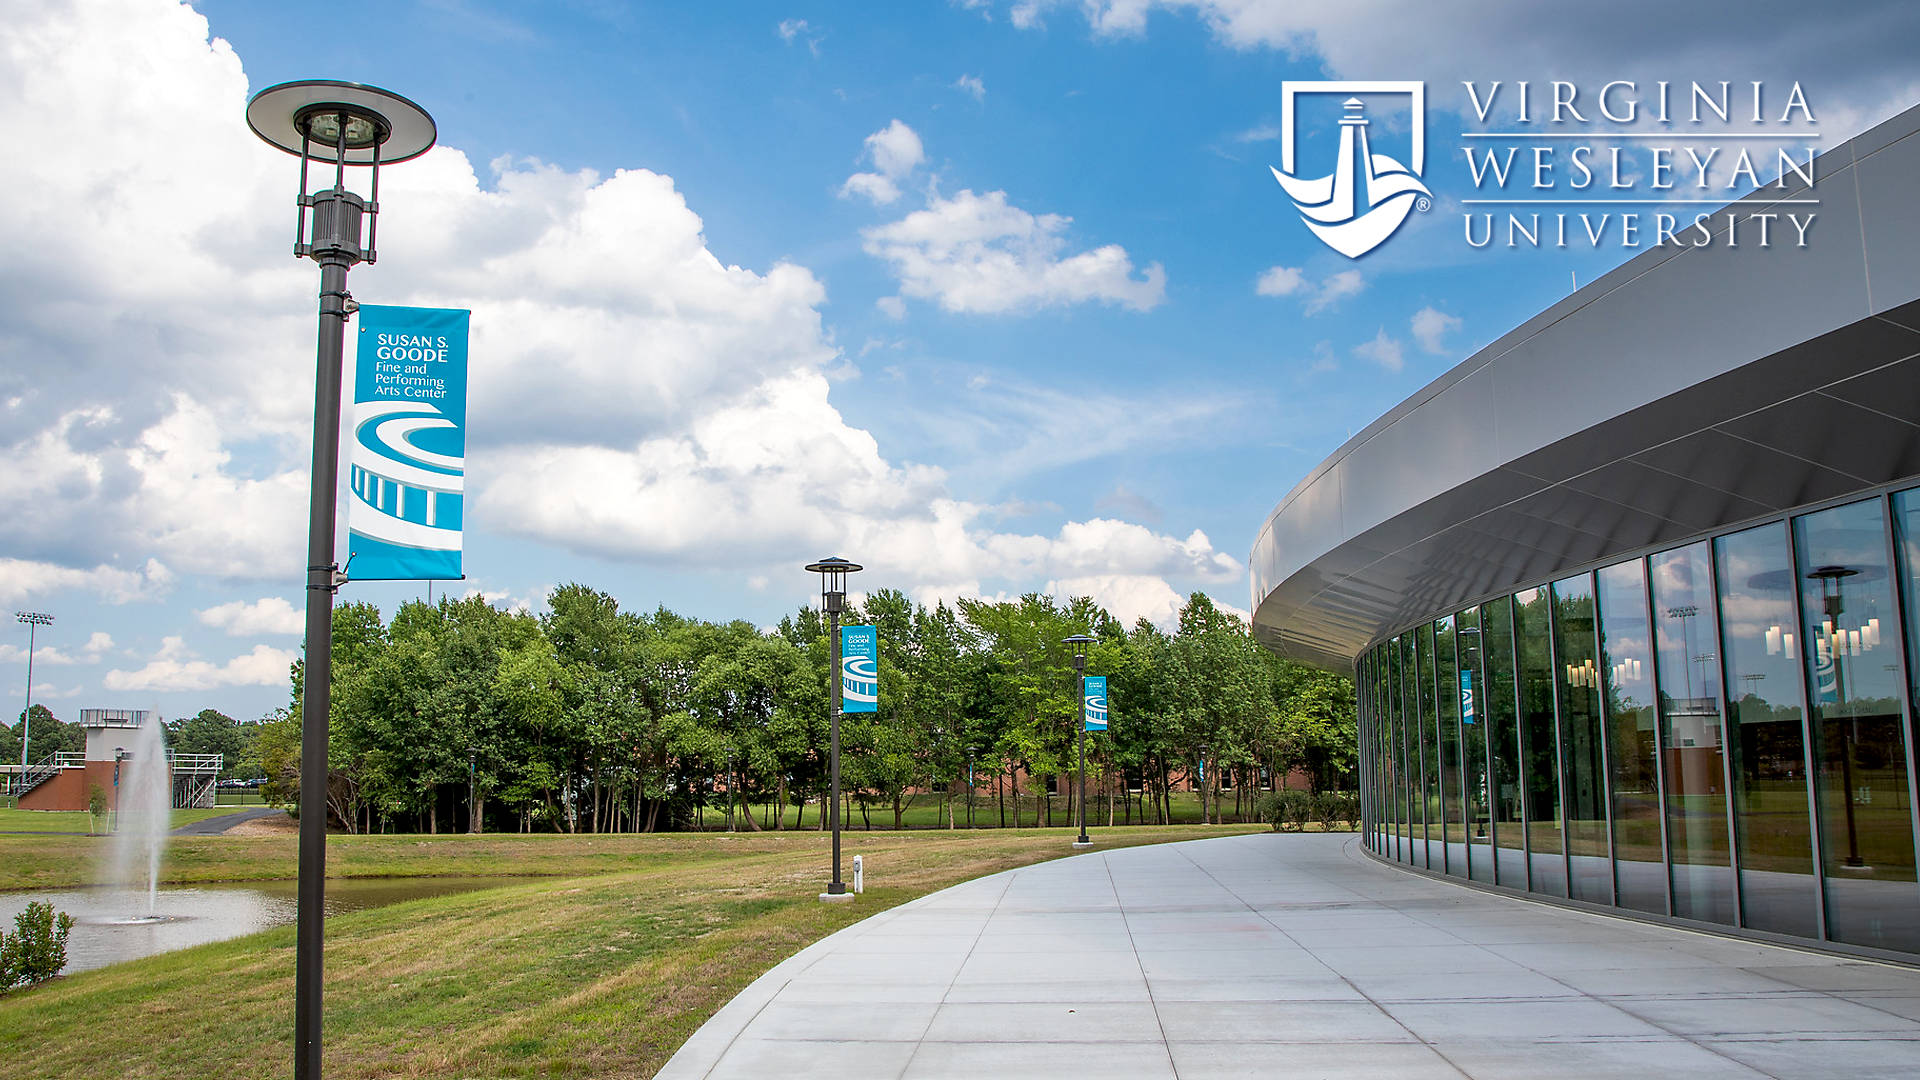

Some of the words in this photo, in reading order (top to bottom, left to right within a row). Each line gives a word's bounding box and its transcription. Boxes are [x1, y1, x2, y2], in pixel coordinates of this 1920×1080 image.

[377, 333, 432, 347] SUSAN
[437, 336, 449, 348] S.
[376, 346, 449, 363] GOODE
[376, 361, 401, 373] Fine
[404, 363, 427, 374] and
[375, 373, 445, 390] Performing
[374, 385, 401, 396] Arts
[404, 386, 447, 399] Center
